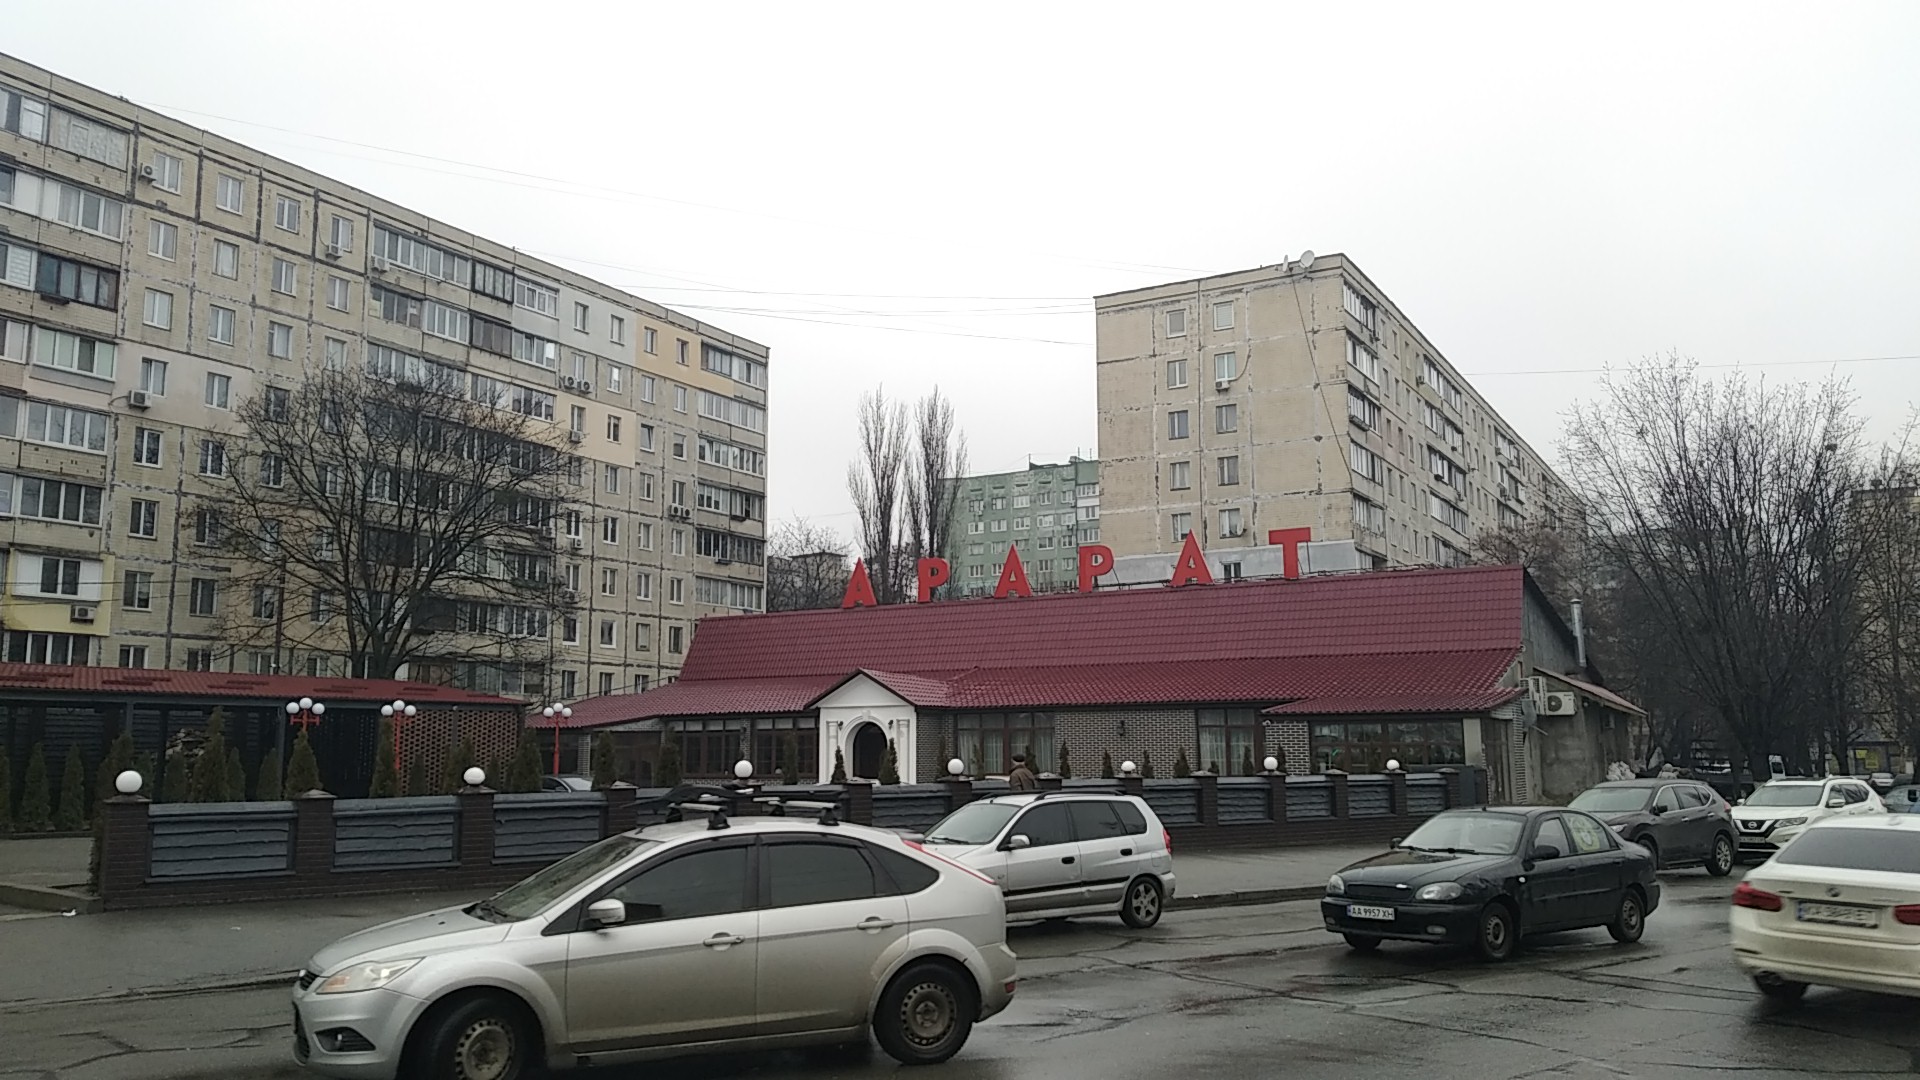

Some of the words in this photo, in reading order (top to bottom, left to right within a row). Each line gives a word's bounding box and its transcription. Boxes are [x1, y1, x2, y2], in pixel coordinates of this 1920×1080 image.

[842, 527, 1311, 608] АРАРАТ
[1352, 907, 1362, 915] AA
[1363, 908, 1381, 917] 9957
